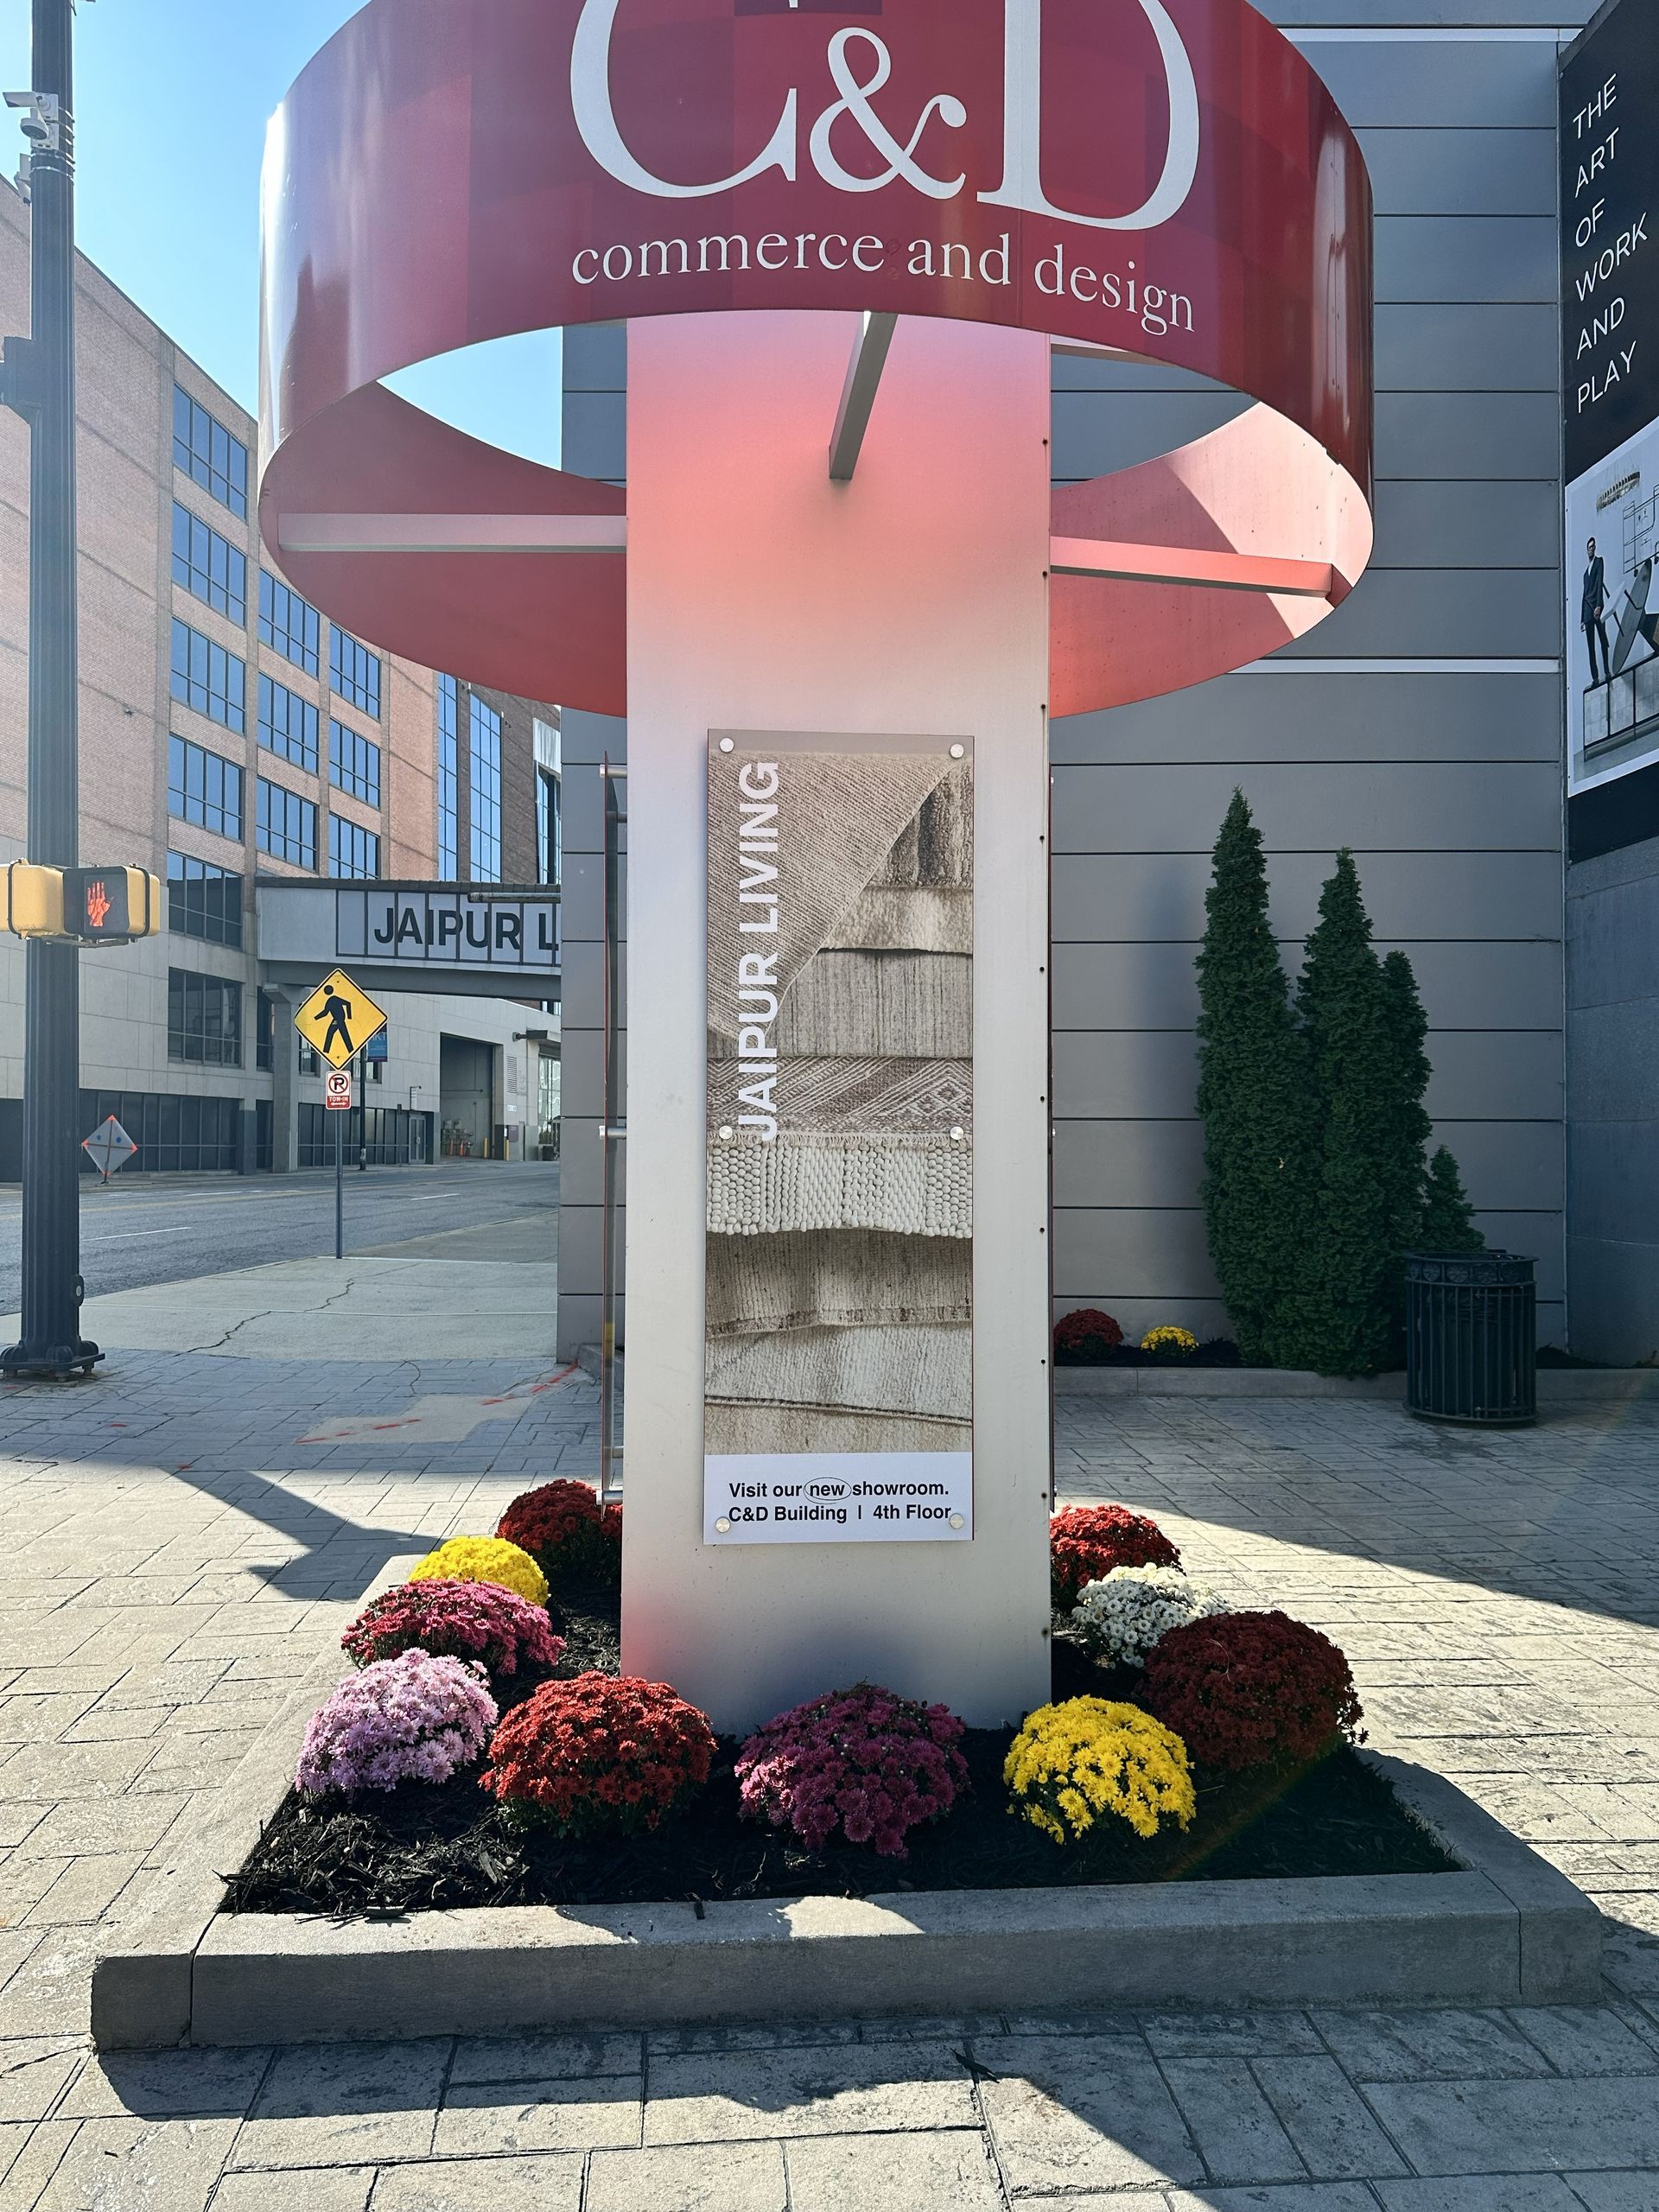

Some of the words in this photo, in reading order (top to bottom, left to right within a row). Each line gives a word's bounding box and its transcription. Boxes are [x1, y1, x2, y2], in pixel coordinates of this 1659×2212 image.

[570, 0, 1201, 231] C&D
[1573, 73, 1617, 139] THE
[1574, 127, 1620, 198] ART
[1575, 198, 1605, 249] OF
[1575, 212, 1648, 302] WORK
[571, 232, 885, 286] commerce
[907, 233, 1012, 286] and
[1034, 243, 1195, 336] design
[1576, 296, 1625, 360] AND
[1578, 340, 1637, 414] PLAY
[739, 762, 779, 933] LIVING
[374, 907, 521, 950] JAIPUR
[738, 952, 779, 1141] JAIPUR
[728, 1506, 768, 1522] C&D
[774, 1505, 848, 1524] Building
[873, 1504, 900, 1520] 4th
[906, 1503, 951, 1520] Floor
[729, 1482, 767, 1497] Visit
[772, 1485, 803, 1497] our
[810, 1484, 845, 1497] new
[852, 1481, 950, 1497] showroom.
